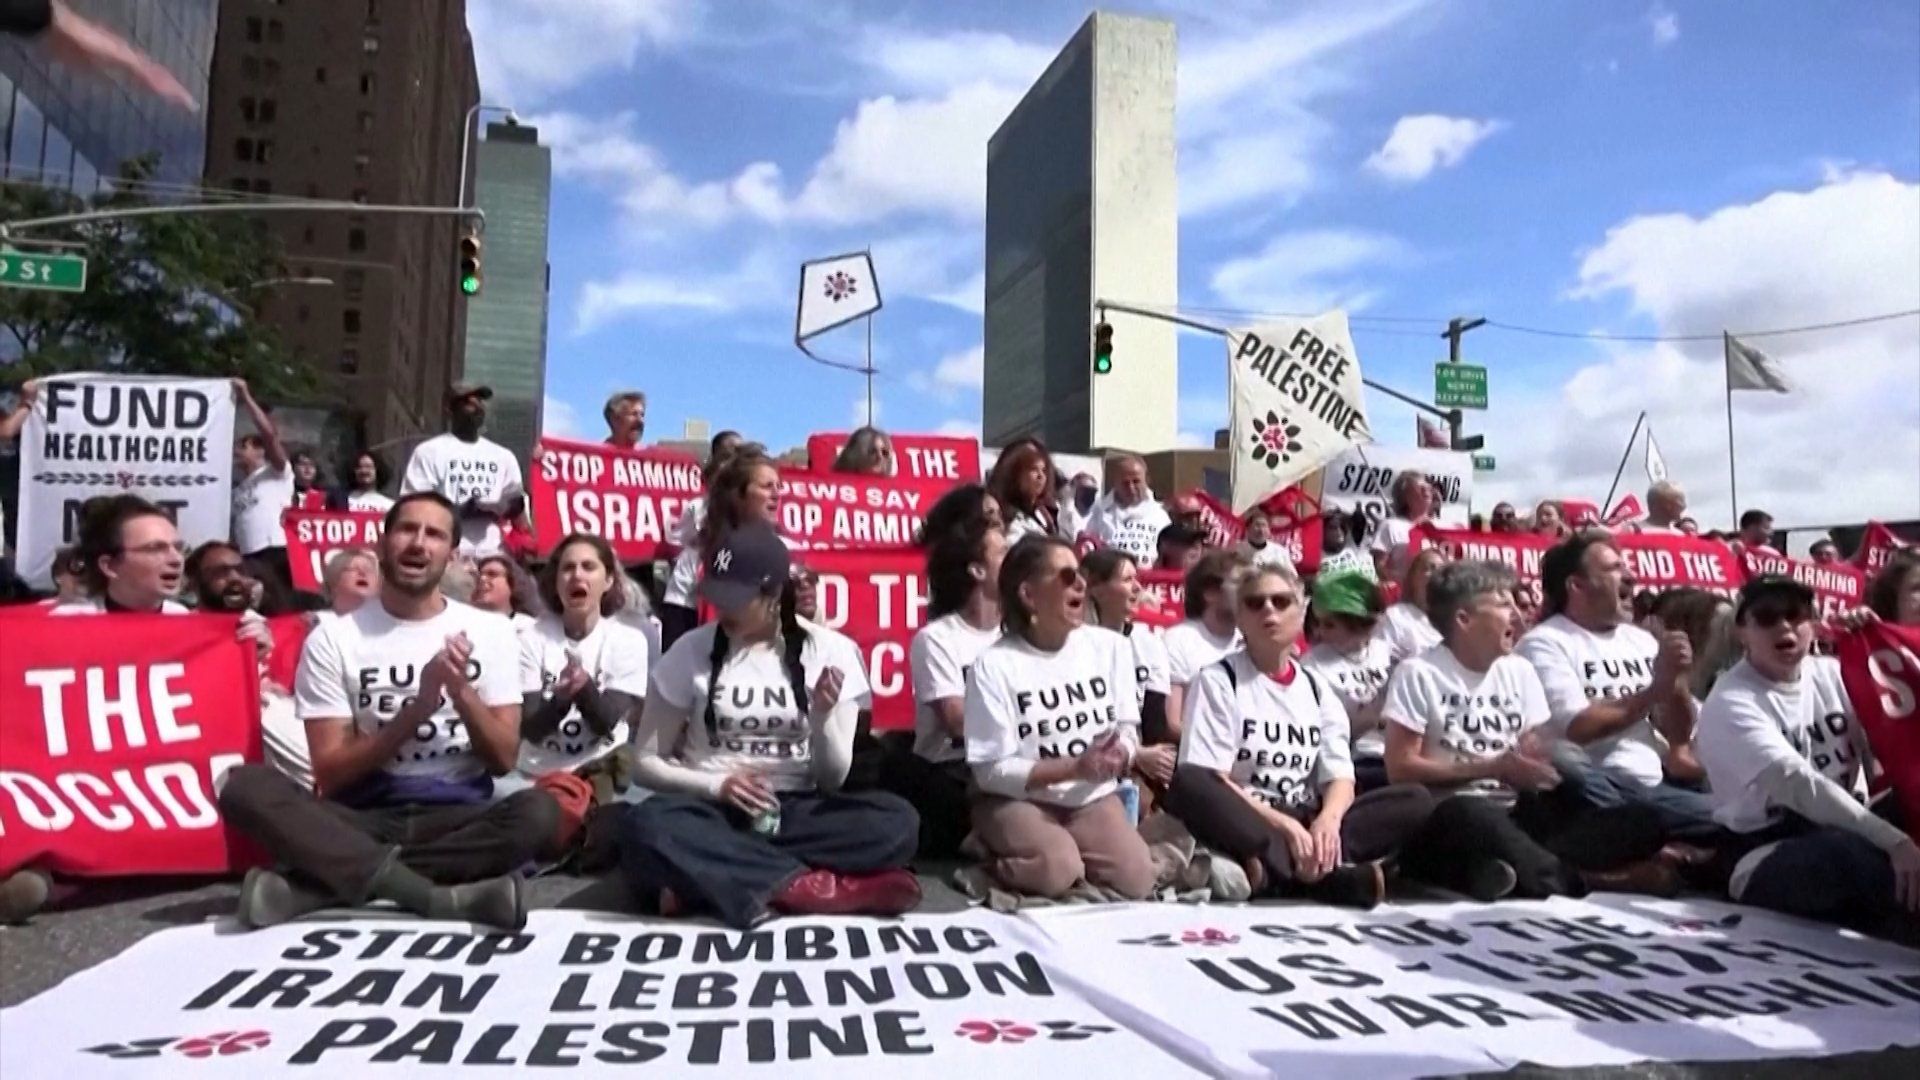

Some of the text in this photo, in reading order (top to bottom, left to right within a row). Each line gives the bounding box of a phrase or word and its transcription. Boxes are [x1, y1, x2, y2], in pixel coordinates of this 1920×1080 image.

[21, 261, 51, 282] St
[1289, 328, 1350, 386] FREE
[1235, 331, 1364, 440] PALESTINE
[45, 381, 209, 430] FUND
[44, 434, 208, 463] HEALTHCARE
[449, 460, 498, 473] FUND
[906, 448, 959, 479] THE
[541, 451, 701, 493] STOP ARMING
[866, 487, 921, 510] SAY
[297, 518, 358, 544] STOP
[782, 502, 824, 535] OP
[1680, 551, 1728, 583] THE
[869, 574, 931, 629] TH
[360, 664, 481, 690] FUD
[25, 663, 201, 756] THE
[1016, 676, 1107, 716] FUND
[1018, 704, 1117, 740] PEOPLE
[1242, 718, 1321, 749] FUND
[1444, 713, 1522, 735] FUND
[1038, 738, 1090, 762] NO
[0, 753, 244, 836] OCID
[280, 924, 1003, 966] STOP BOMBING
[1468, 915, 1656, 942] THE
[181, 951, 1056, 1014] IRAN LEBANON
[1186, 953, 1384, 995] US
[1249, 994, 1530, 1040] WAR
[286, 1010, 935, 1067] PALESTINE
